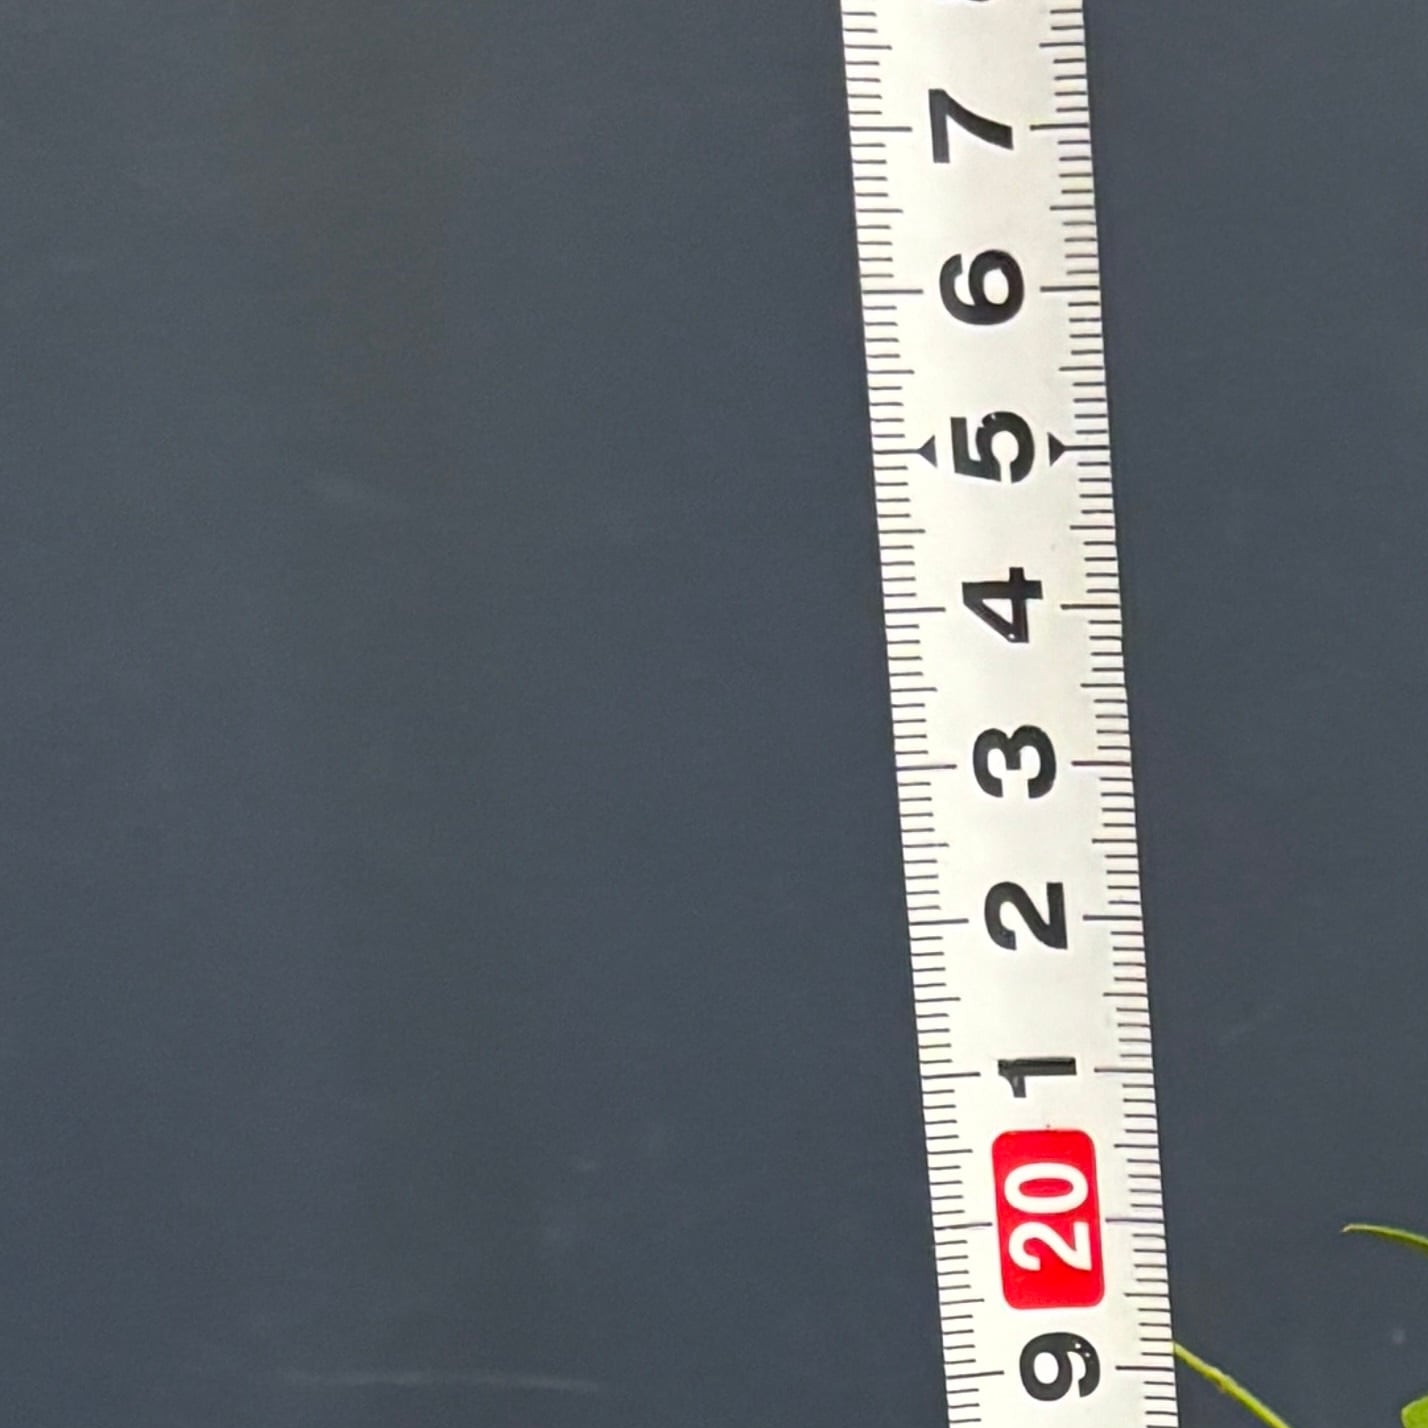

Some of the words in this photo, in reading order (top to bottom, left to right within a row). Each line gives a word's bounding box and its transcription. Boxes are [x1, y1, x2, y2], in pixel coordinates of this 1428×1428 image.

[928, 88, 1013, 163] 7
[939, 249, 1025, 326] 6
[950, 411, 1036, 484] 5
[961, 566, 1043, 644] 4
[972, 725, 1057, 799] 3
[984, 881, 1068, 950] 2
[997, 1057, 1077, 1098] 1
[1002, 1161, 1093, 1272] 20
[1019, 1332, 1100, 1402] 9
